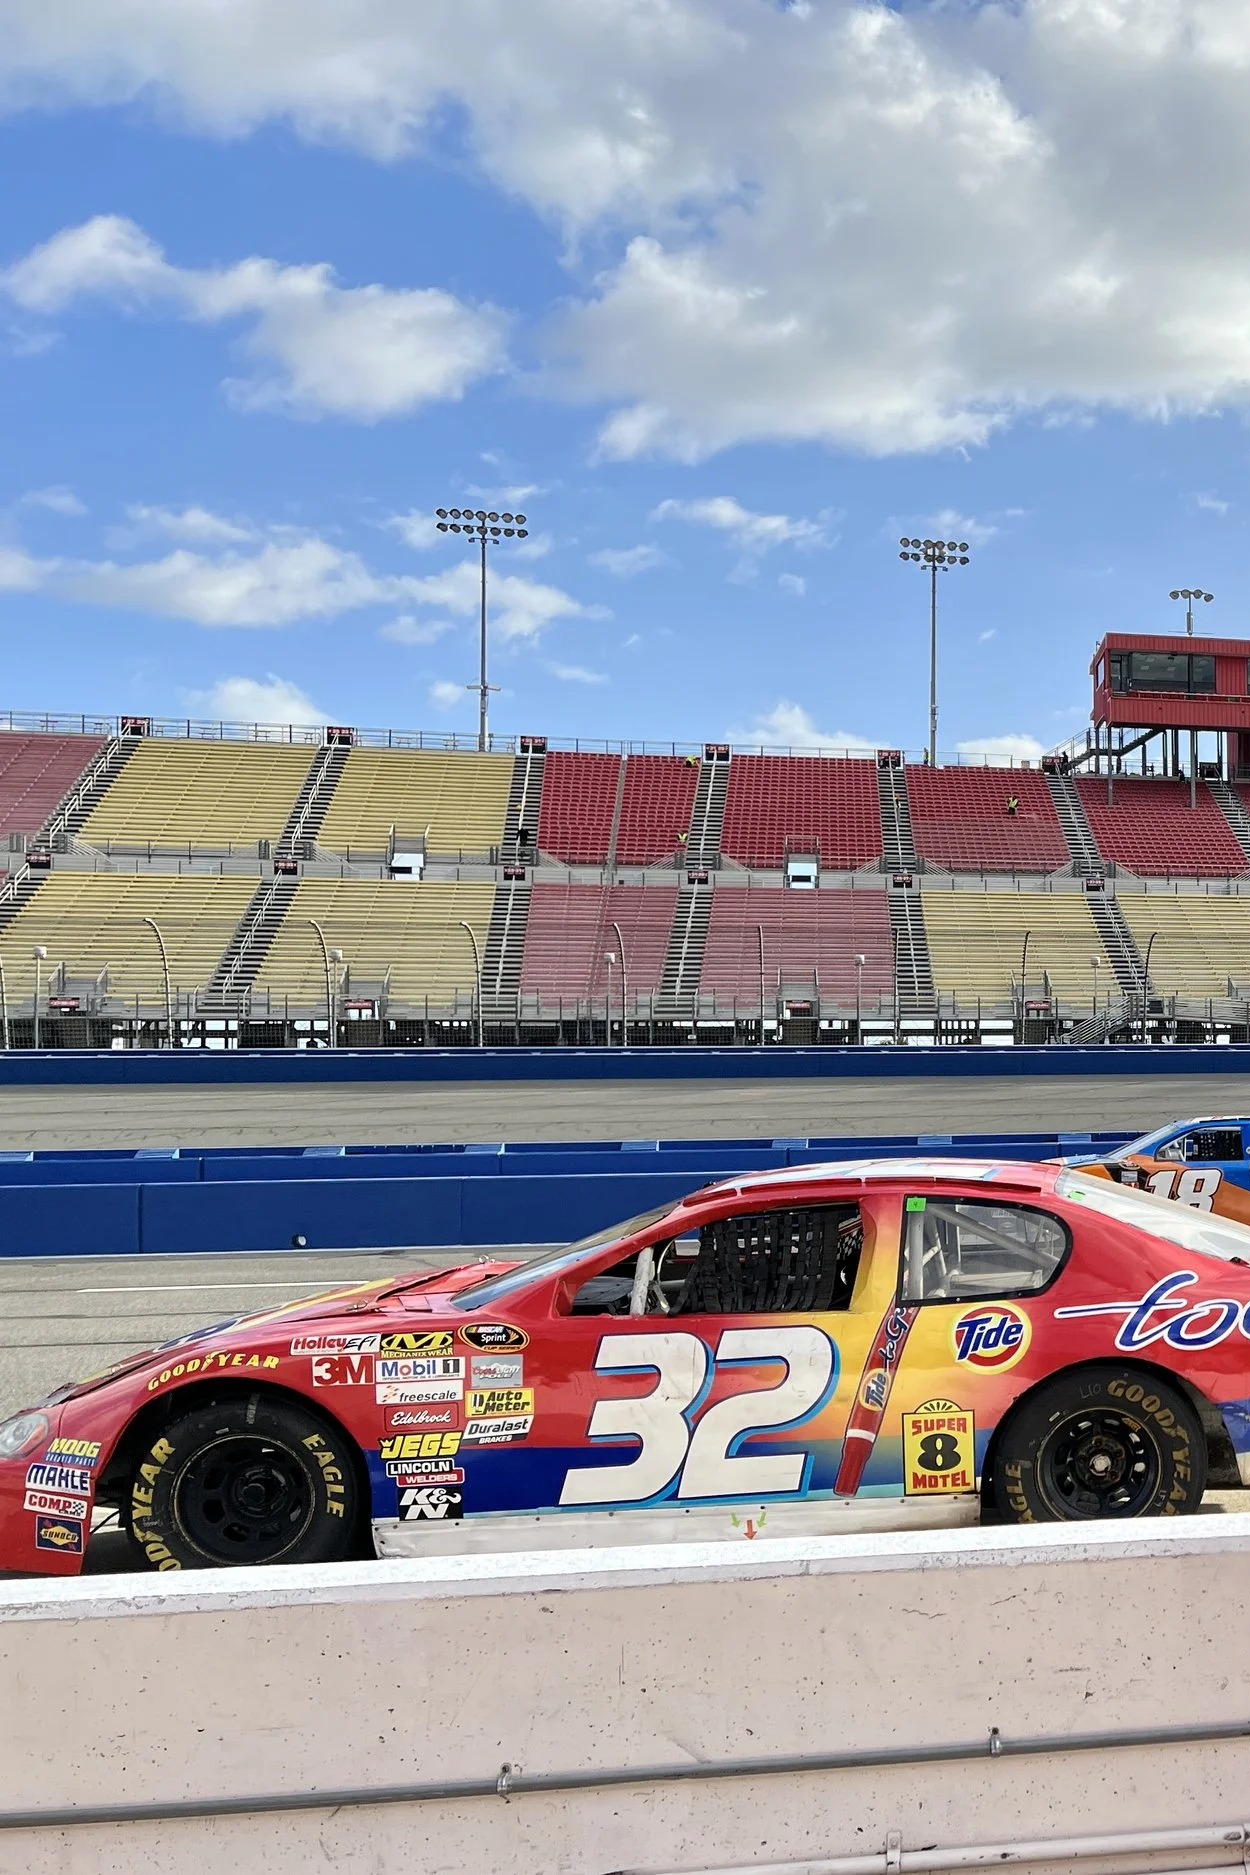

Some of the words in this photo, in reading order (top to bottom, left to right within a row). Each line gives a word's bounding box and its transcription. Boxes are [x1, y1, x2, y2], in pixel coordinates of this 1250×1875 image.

[1146, 1169, 1222, 1213] 18
[293, 1336, 347, 1353] Holley
[343, 1335, 377, 1352] EFI
[480, 1333, 507, 1343] Sprint
[956, 1315, 1024, 1361] Tide
[381, 1350, 427, 1359] MECHANIX
[427, 1348, 454, 1357] WEAR
[147, 1349, 280, 1391] GOODYEAR
[314, 1356, 373, 1385] 3M
[381, 1360, 436, 1377] Mobil
[399, 1391, 457, 1403] freescale
[486, 1391, 523, 1402] Auto
[863, 1372, 888, 1408] Tide
[483, 1401, 530, 1413] Meter
[558, 1324, 838, 1506] 32
[391, 1410, 452, 1426] Edelbrock
[468, 1418, 529, 1435] Duralast
[911, 1416, 968, 1436] SUPER
[47, 1438, 102, 1458] MOOG
[381, 1432, 463, 1459] JEGS
[478, 1434, 513, 1444] BRAKES
[917, 1433, 962, 1472] 8
[302, 1433, 345, 1518] EAGLE
[390, 1461, 450, 1475] LINCOLN
[27, 1464, 89, 1491] MAHLE
[405, 1474, 458, 1484] WELDERS
[912, 1470, 971, 1490] MOTEL
[28, 1494, 72, 1511] COMP
[42, 1529, 78, 1542] SUNOCO
